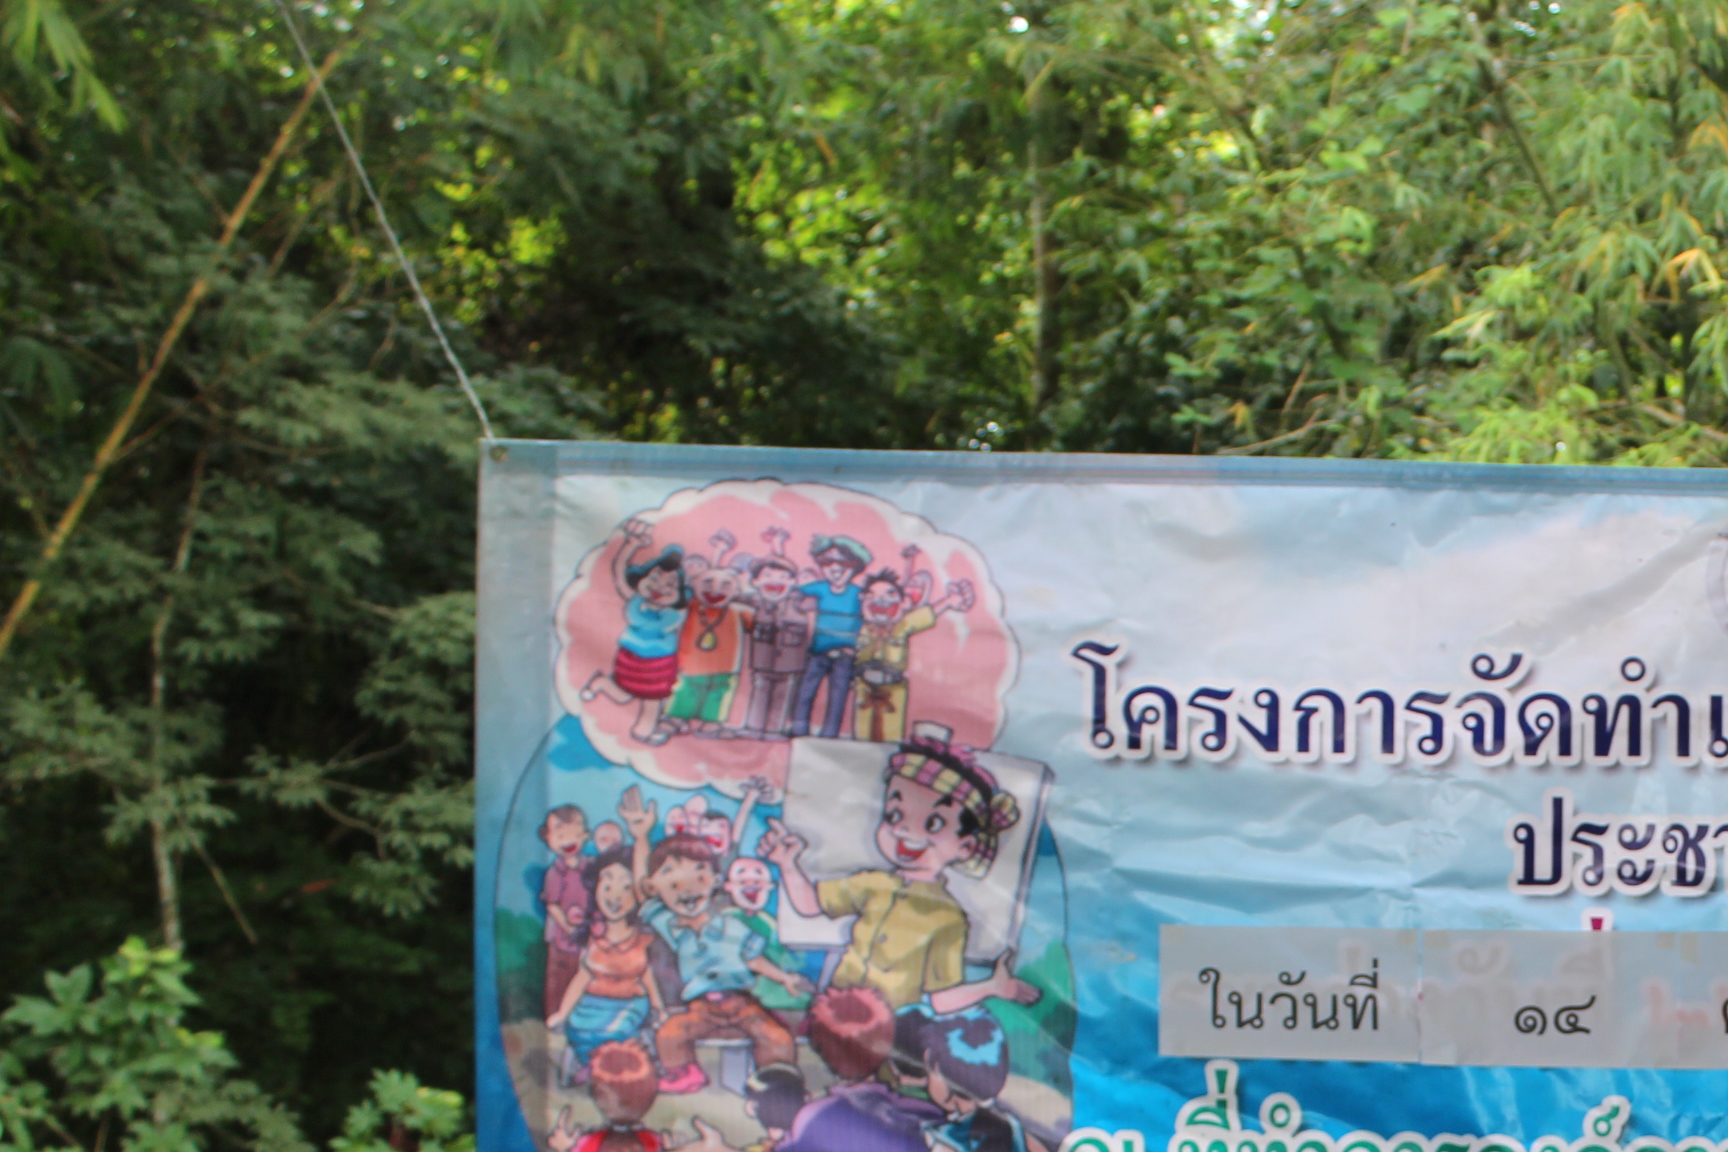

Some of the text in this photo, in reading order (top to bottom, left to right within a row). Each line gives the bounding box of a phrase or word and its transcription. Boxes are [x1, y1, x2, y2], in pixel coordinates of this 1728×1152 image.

[1199, 957, 1379, 1031] ในวันที่
[1514, 995, 1597, 1036] ๑๔
